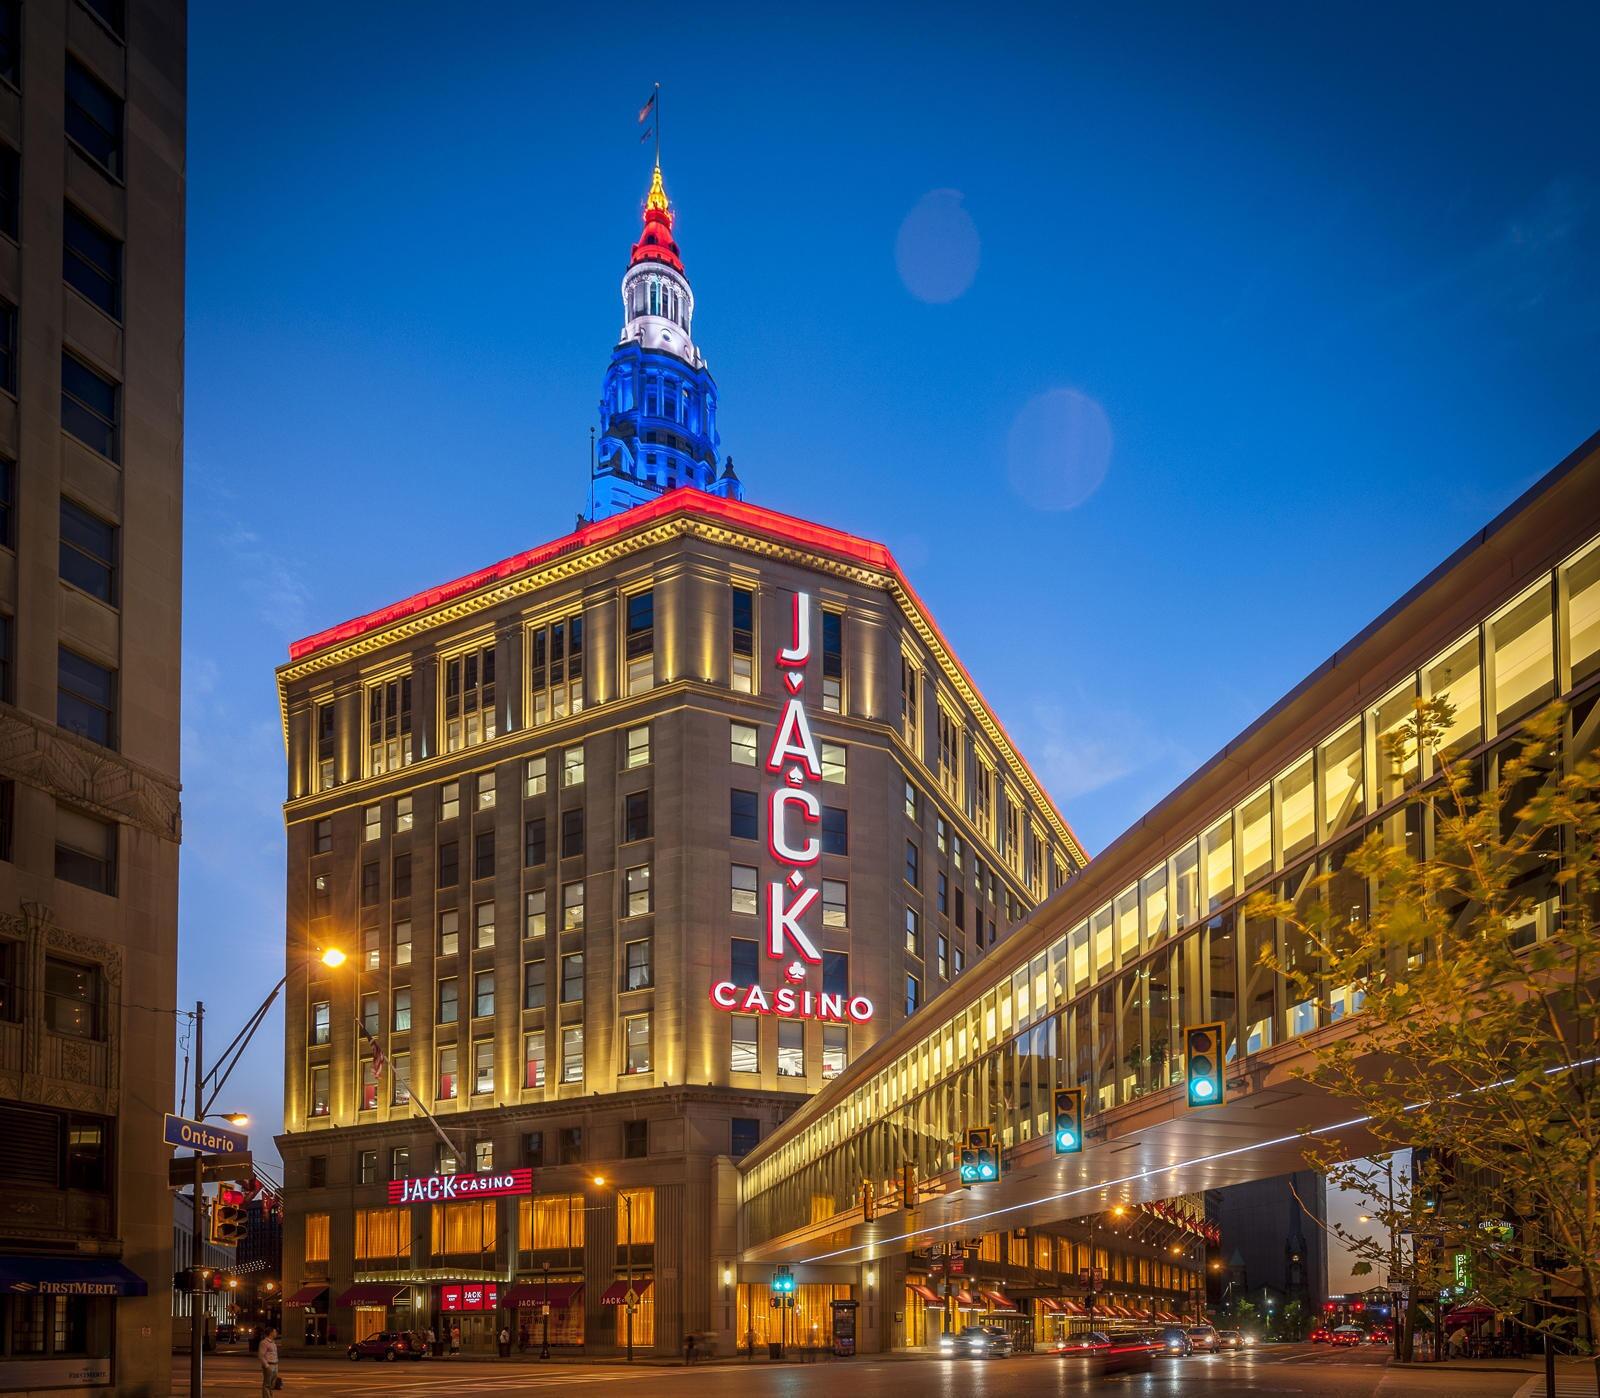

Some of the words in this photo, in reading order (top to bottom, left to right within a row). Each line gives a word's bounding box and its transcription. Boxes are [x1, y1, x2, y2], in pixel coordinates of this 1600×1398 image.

[766, 592, 823, 962] JACK
[710, 981, 875, 1022] CASINO
[180, 1124, 234, 1152] Ontario
[400, 1176, 457, 1202] JACK
[460, 1176, 514, 1191] CASINO
[464, 1291, 482, 1299] JACK
[518, 1299, 536, 1307] JACK
[601, 1297, 621, 1305] JACK
